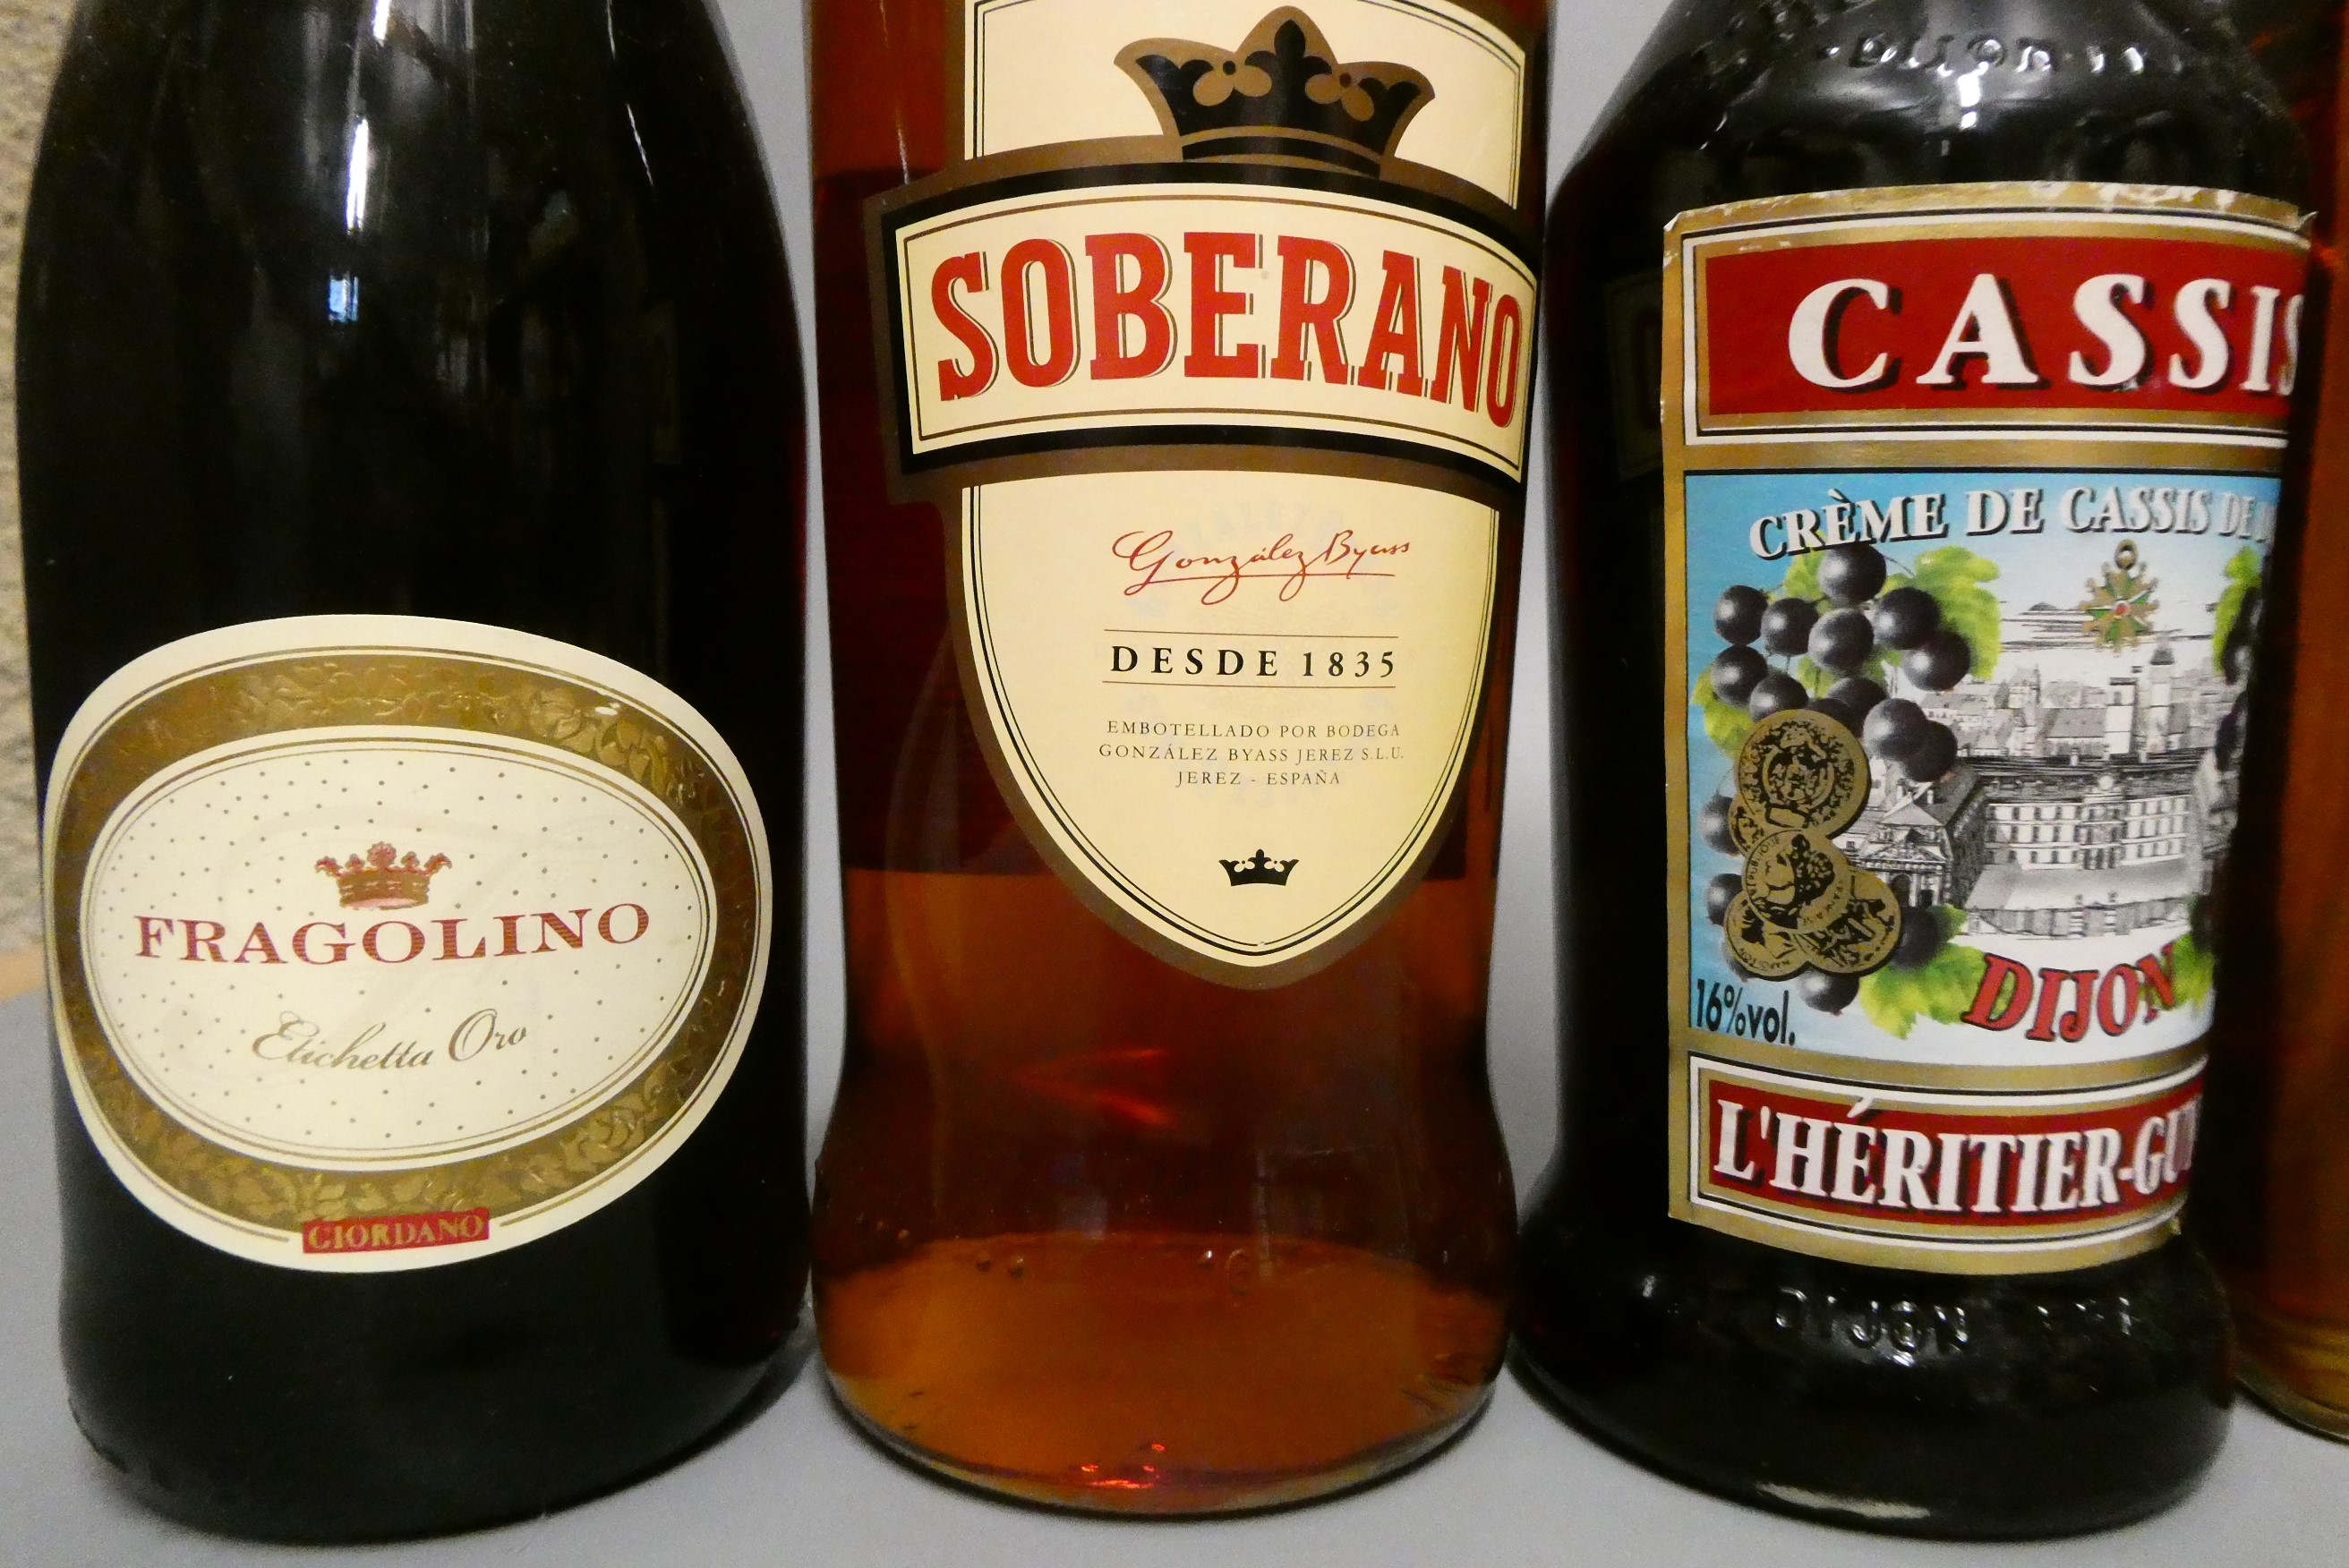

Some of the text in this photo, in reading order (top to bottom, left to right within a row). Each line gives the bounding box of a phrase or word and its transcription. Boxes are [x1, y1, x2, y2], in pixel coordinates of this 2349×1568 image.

[931, 231, 1525, 430] SOBERANO
[1789, 272, 2304, 399] CASSIS
[1749, 488, 1950, 560] CRÈME
[1965, 487, 2045, 535] DE
[2061, 486, 2213, 535] CASSIS
[1110, 645, 1396, 677] DESDE 1835
[1098, 743, 1405, 766] GONZÁLEZ BYASS JEREZ S.L.U.
[1106, 720, 1401, 739] EMBOTELLADO POR BODEGA
[1174, 771, 1242, 788] JEREZ
[1266, 770, 1341, 786] ESPAÑA
[134, 902, 650, 966] FRAGOLINO
[1960, 942, 2178, 1044] DIJON
[251, 1007, 528, 1071] Etichetta Oro
[307, 1214, 485, 1250] GIORDANO
